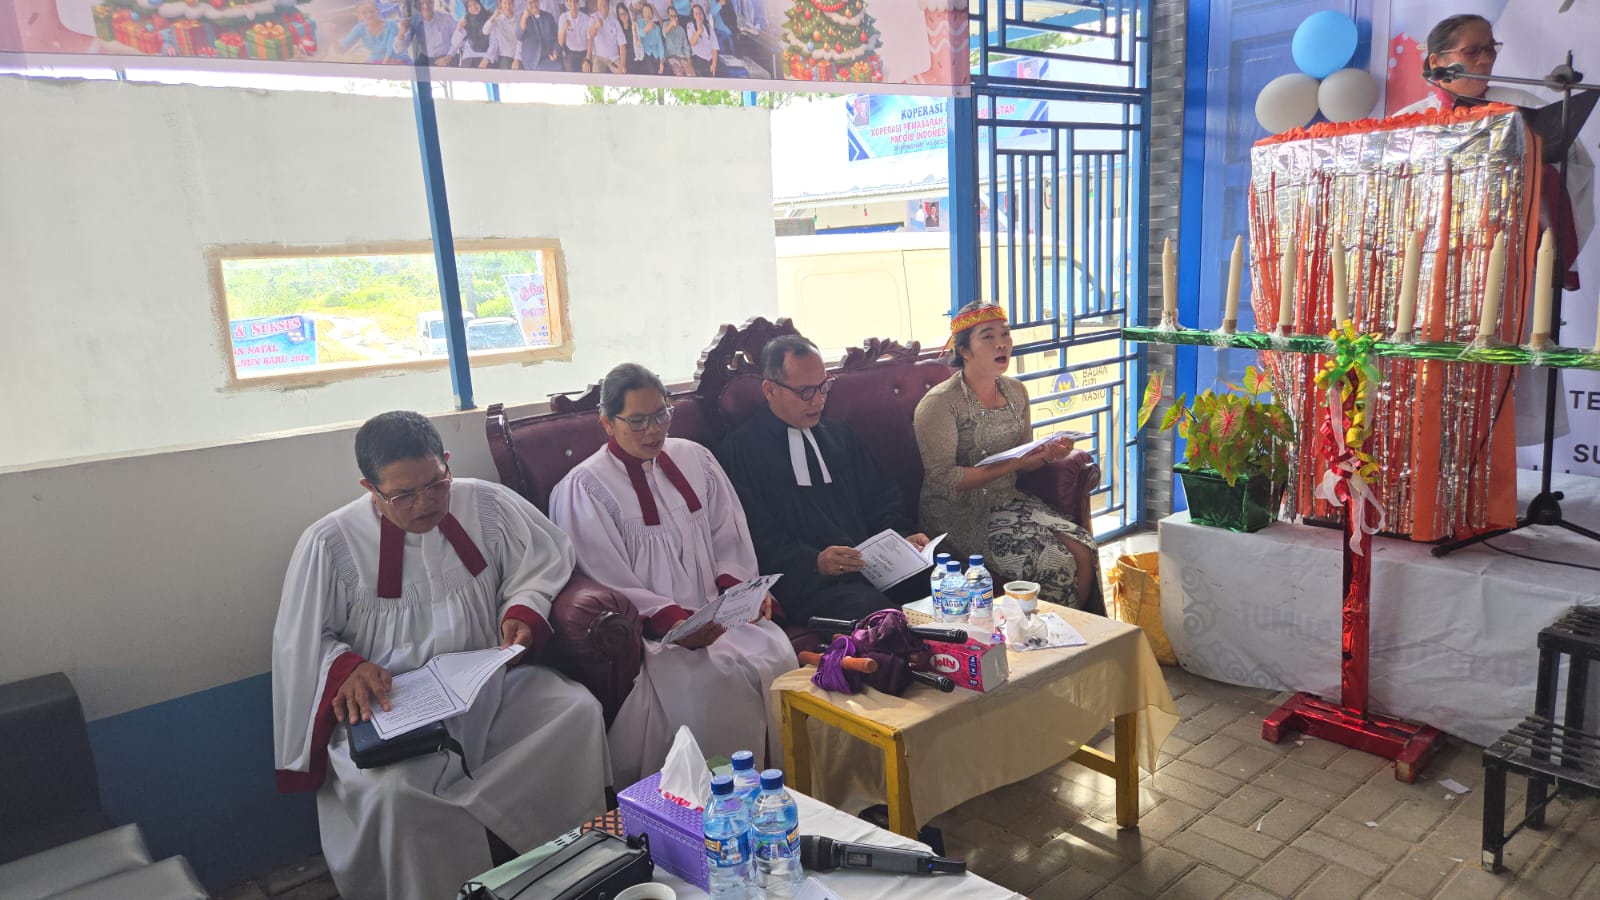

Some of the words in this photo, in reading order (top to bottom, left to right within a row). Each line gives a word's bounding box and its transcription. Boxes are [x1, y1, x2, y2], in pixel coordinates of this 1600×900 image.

[901, 102, 943, 120] KOPERASI
[871, 125, 902, 137] KOPERASI
[916, 128, 948, 140] INDONES
[247, 344, 279, 354] NATAL
[1082, 366, 1108, 379] BADAN
